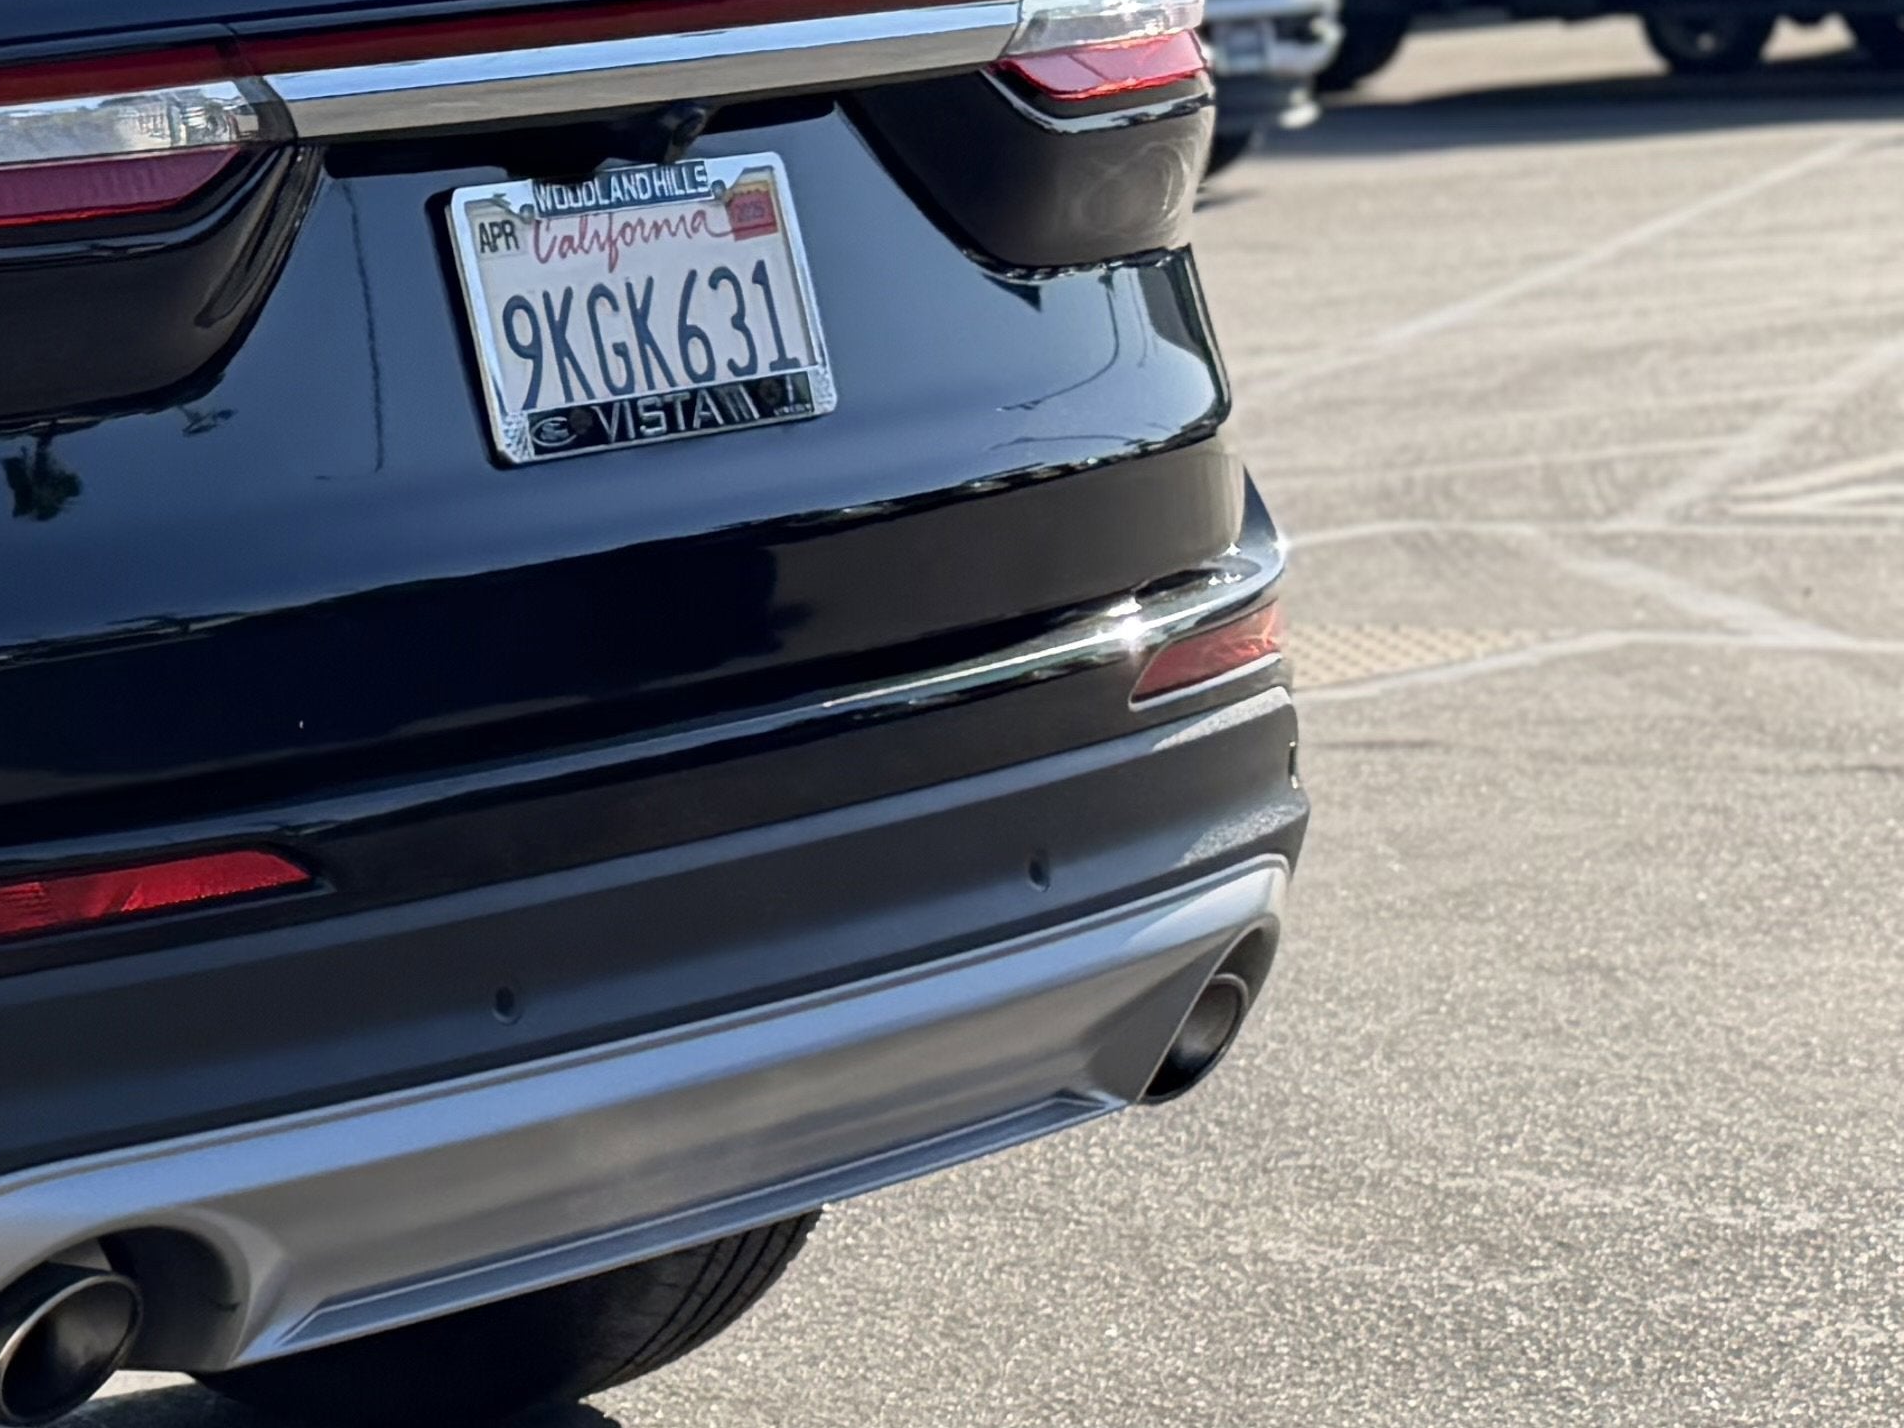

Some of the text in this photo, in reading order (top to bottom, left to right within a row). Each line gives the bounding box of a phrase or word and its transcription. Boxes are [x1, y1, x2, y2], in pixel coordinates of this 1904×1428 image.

[534, 164, 710, 213] WOODLAND HILLS
[478, 217, 520, 254] APR
[532, 207, 735, 273] California
[501, 259, 801, 411] 9KGK631
[593, 388, 725, 443] VISTA
